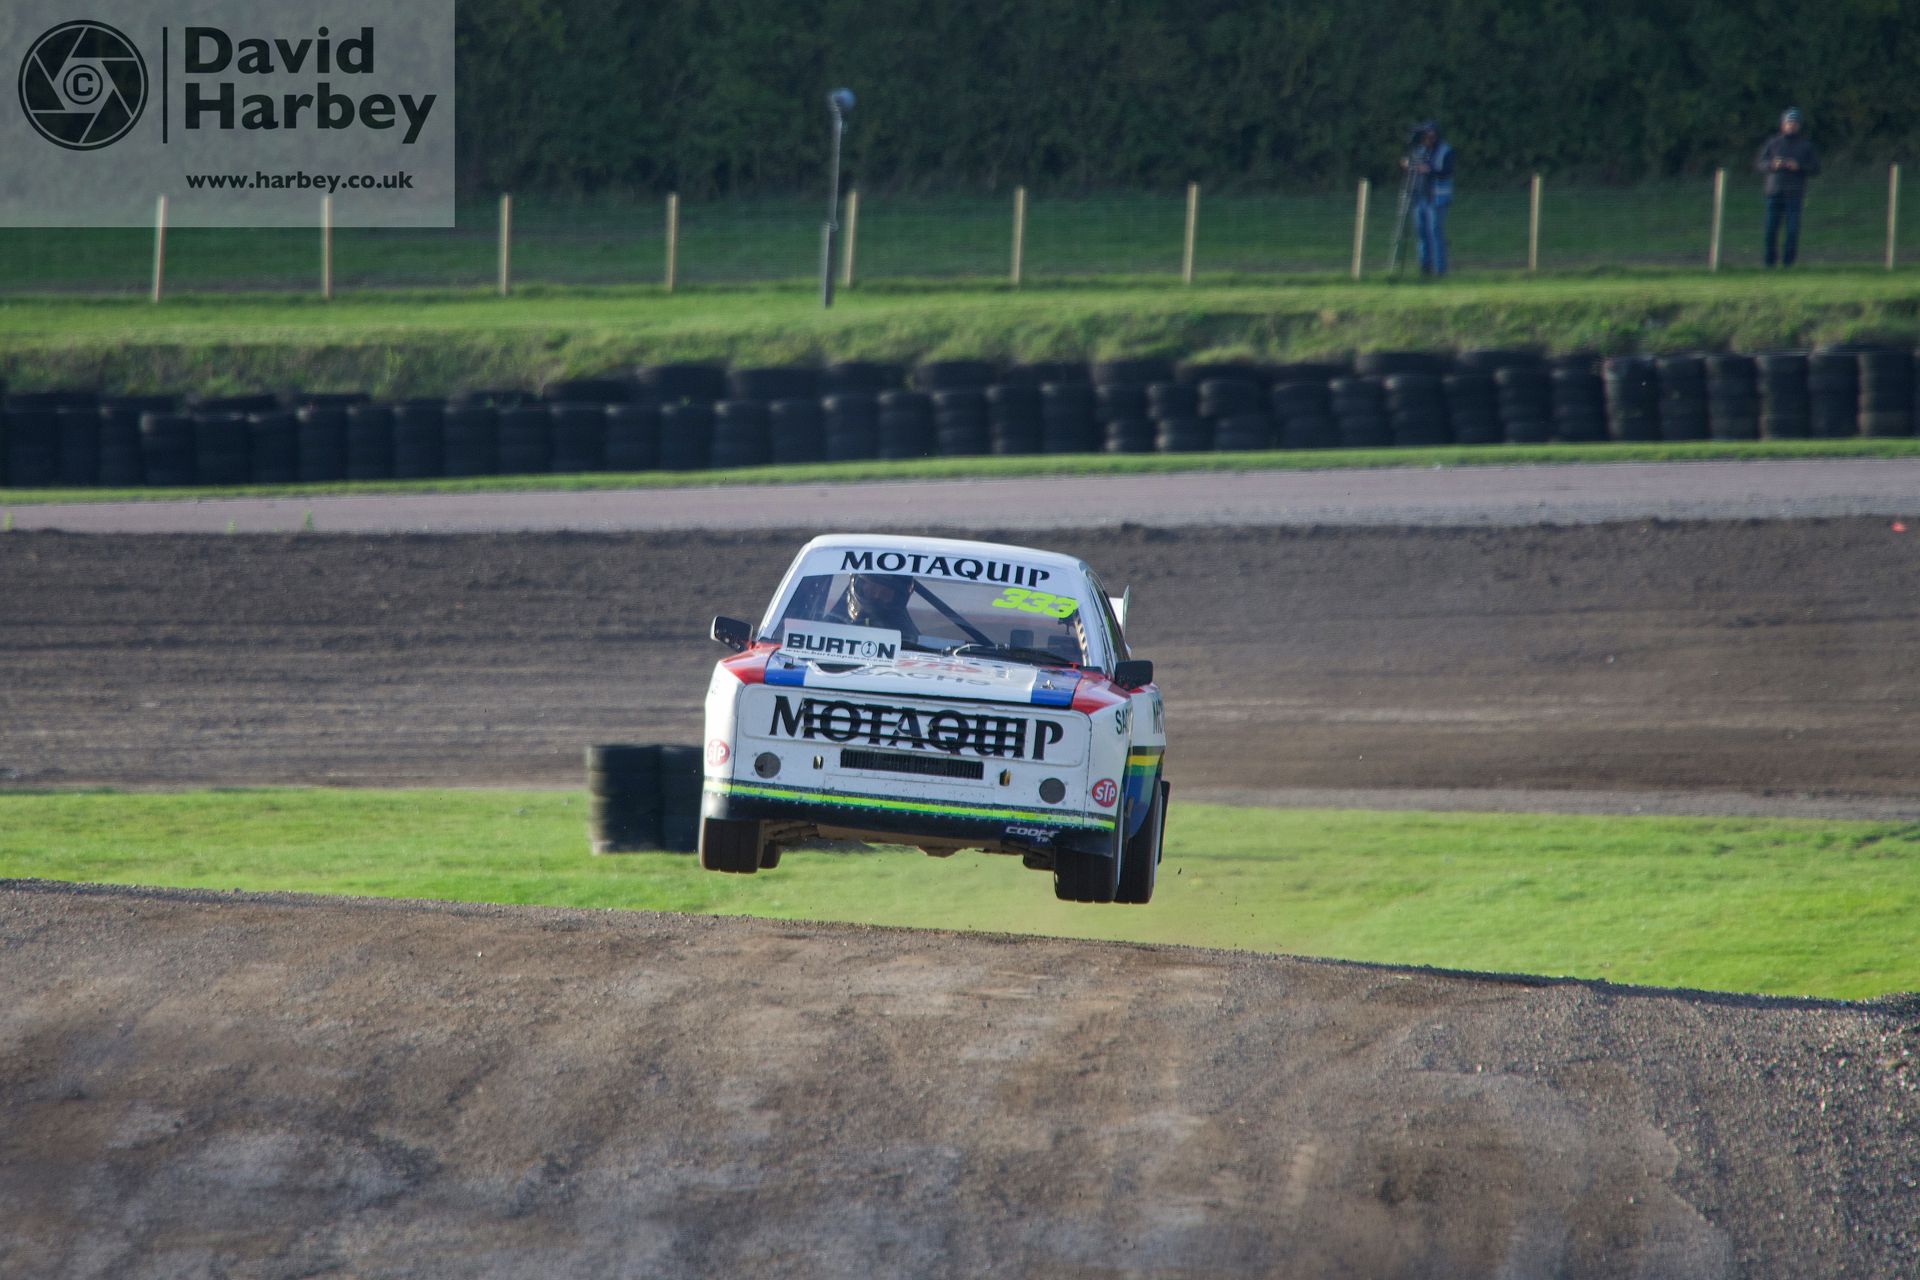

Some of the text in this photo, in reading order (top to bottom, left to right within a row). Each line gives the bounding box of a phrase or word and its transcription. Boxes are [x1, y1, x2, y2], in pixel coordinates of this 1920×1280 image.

[840, 551, 1050, 588] MOTAQUIP
[992, 587, 1079, 619] 333
[786, 632, 897, 660] BURTON
[769, 695, 1064, 760] MOTAQUIP
[1093, 780, 1117, 804] STP
